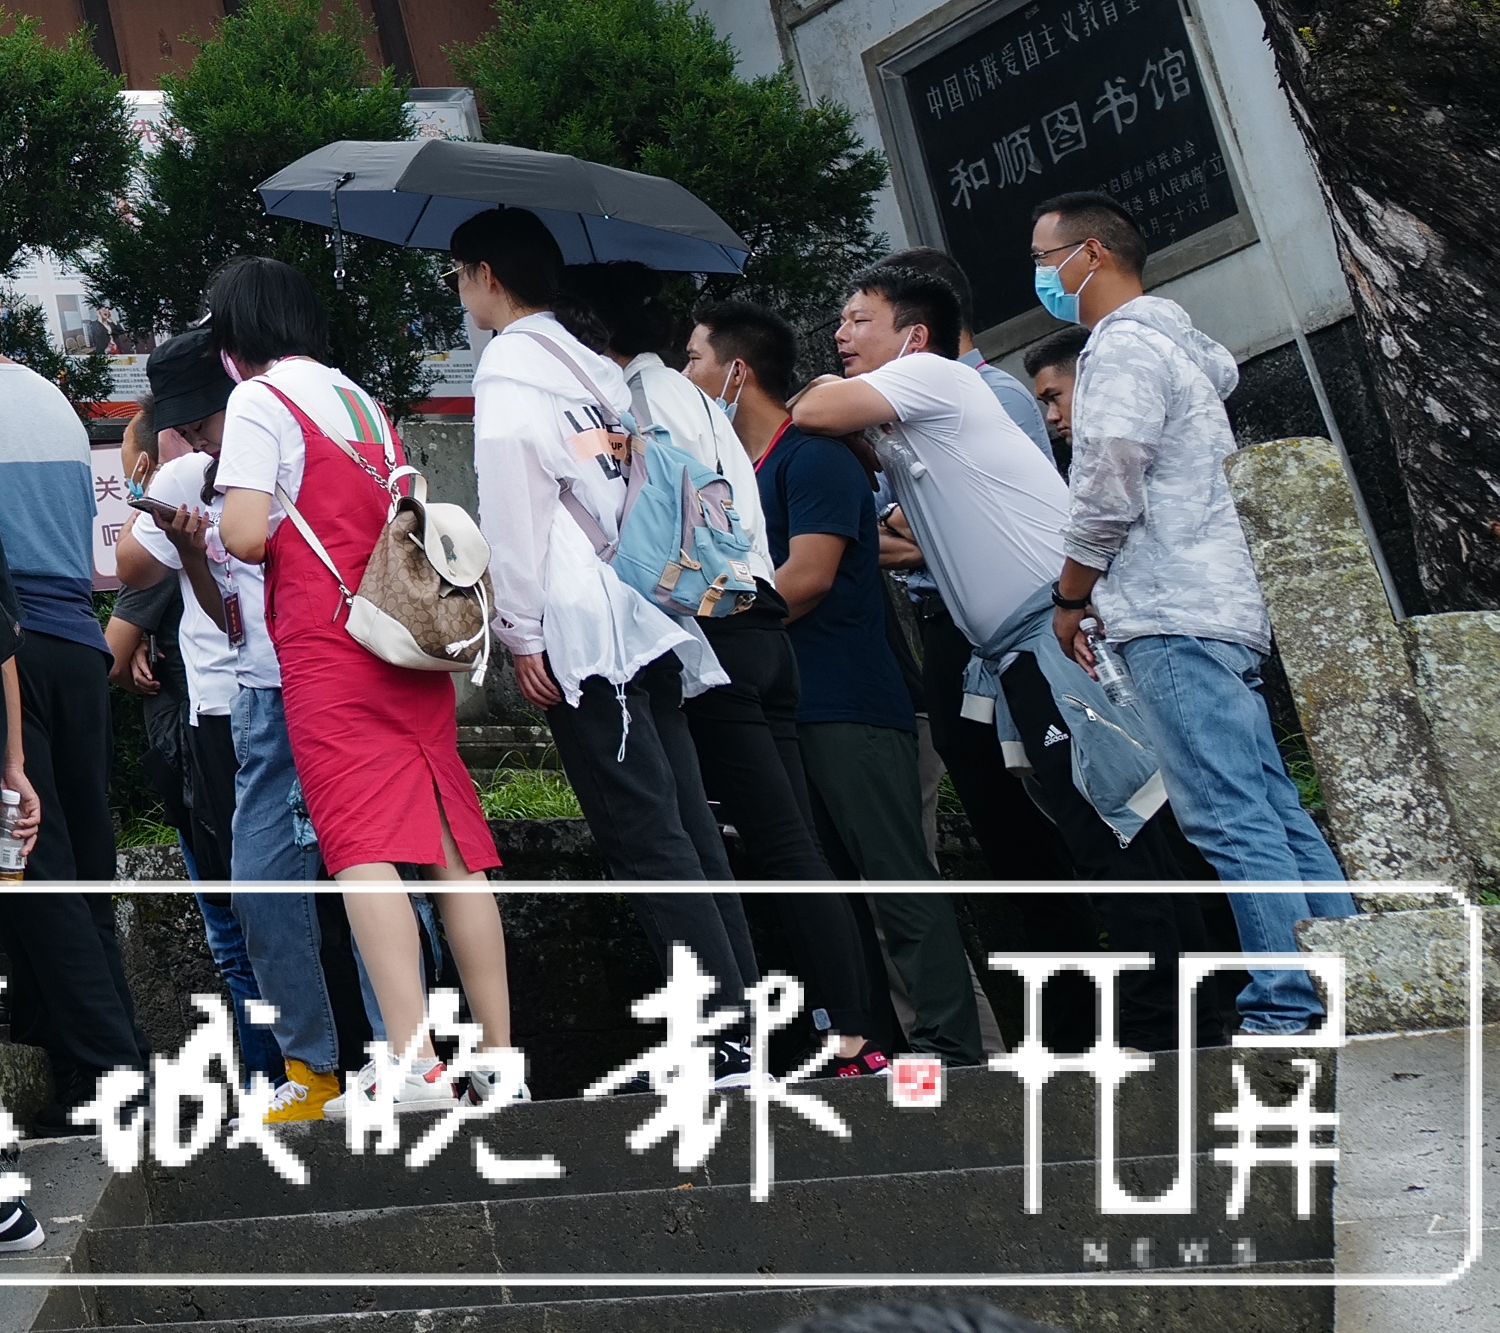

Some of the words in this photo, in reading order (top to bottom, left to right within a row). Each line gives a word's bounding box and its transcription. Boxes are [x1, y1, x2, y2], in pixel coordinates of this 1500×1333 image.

[947, 46, 1192, 210] 和顺图书馆
[1043, 733, 1069, 747] adidas
